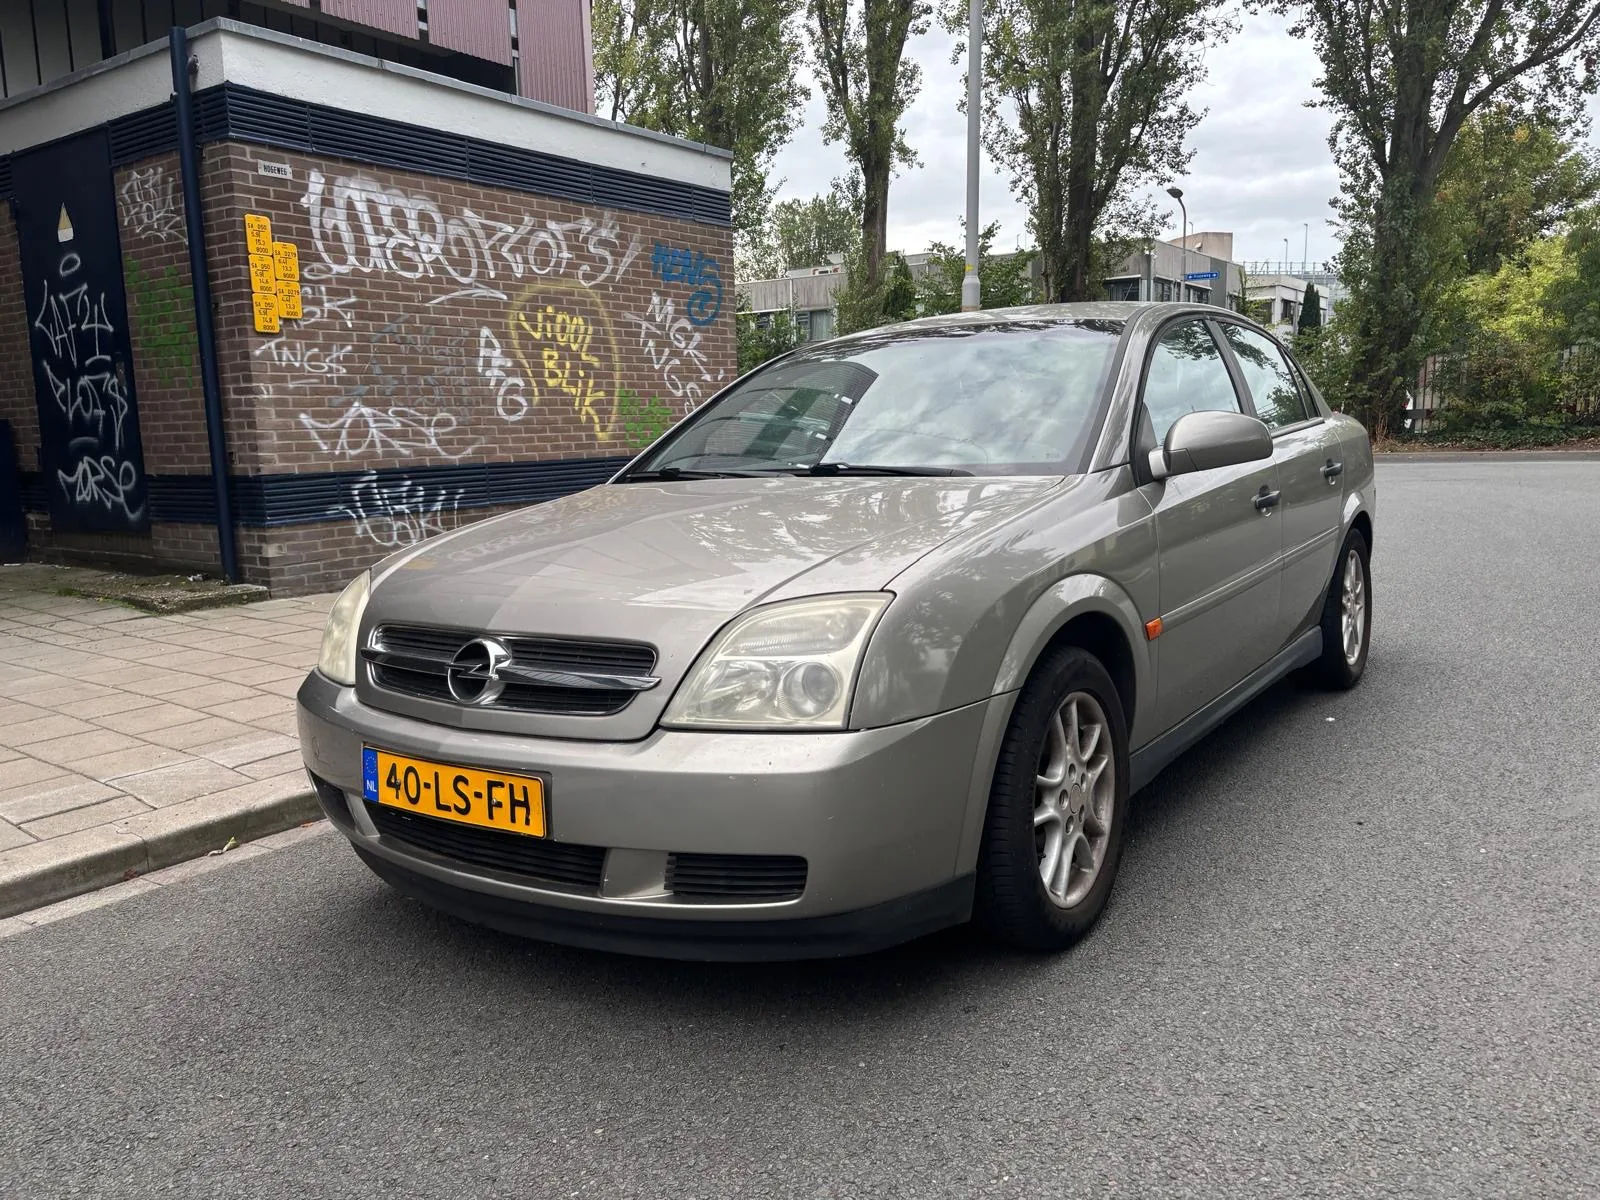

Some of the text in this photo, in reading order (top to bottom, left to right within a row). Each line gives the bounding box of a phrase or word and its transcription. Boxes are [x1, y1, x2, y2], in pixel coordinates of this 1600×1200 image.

[264, 164, 288, 176] HOGEWEG
[366, 762, 531, 827] NL 40-LS-FH
